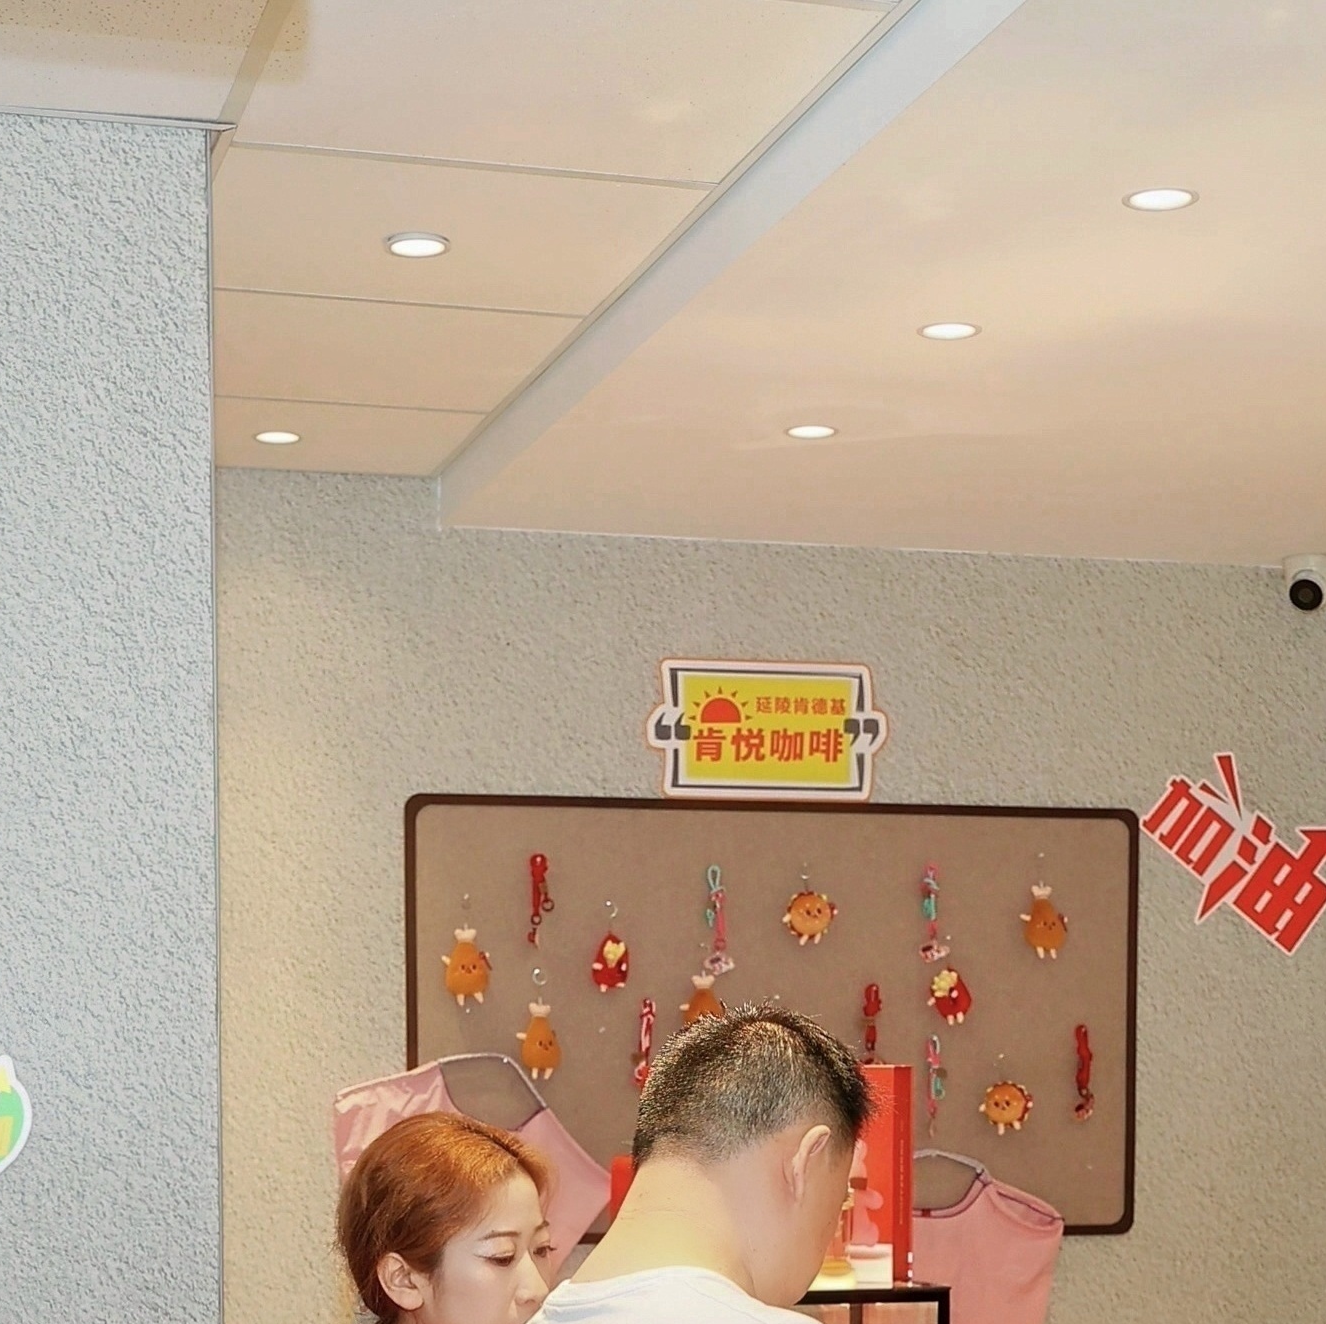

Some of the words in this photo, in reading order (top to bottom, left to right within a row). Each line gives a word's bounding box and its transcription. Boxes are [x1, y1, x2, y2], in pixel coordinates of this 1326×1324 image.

[756, 696, 846, 716] 延陵肯德基
[693, 727, 844, 763] 肯悦咖啡
